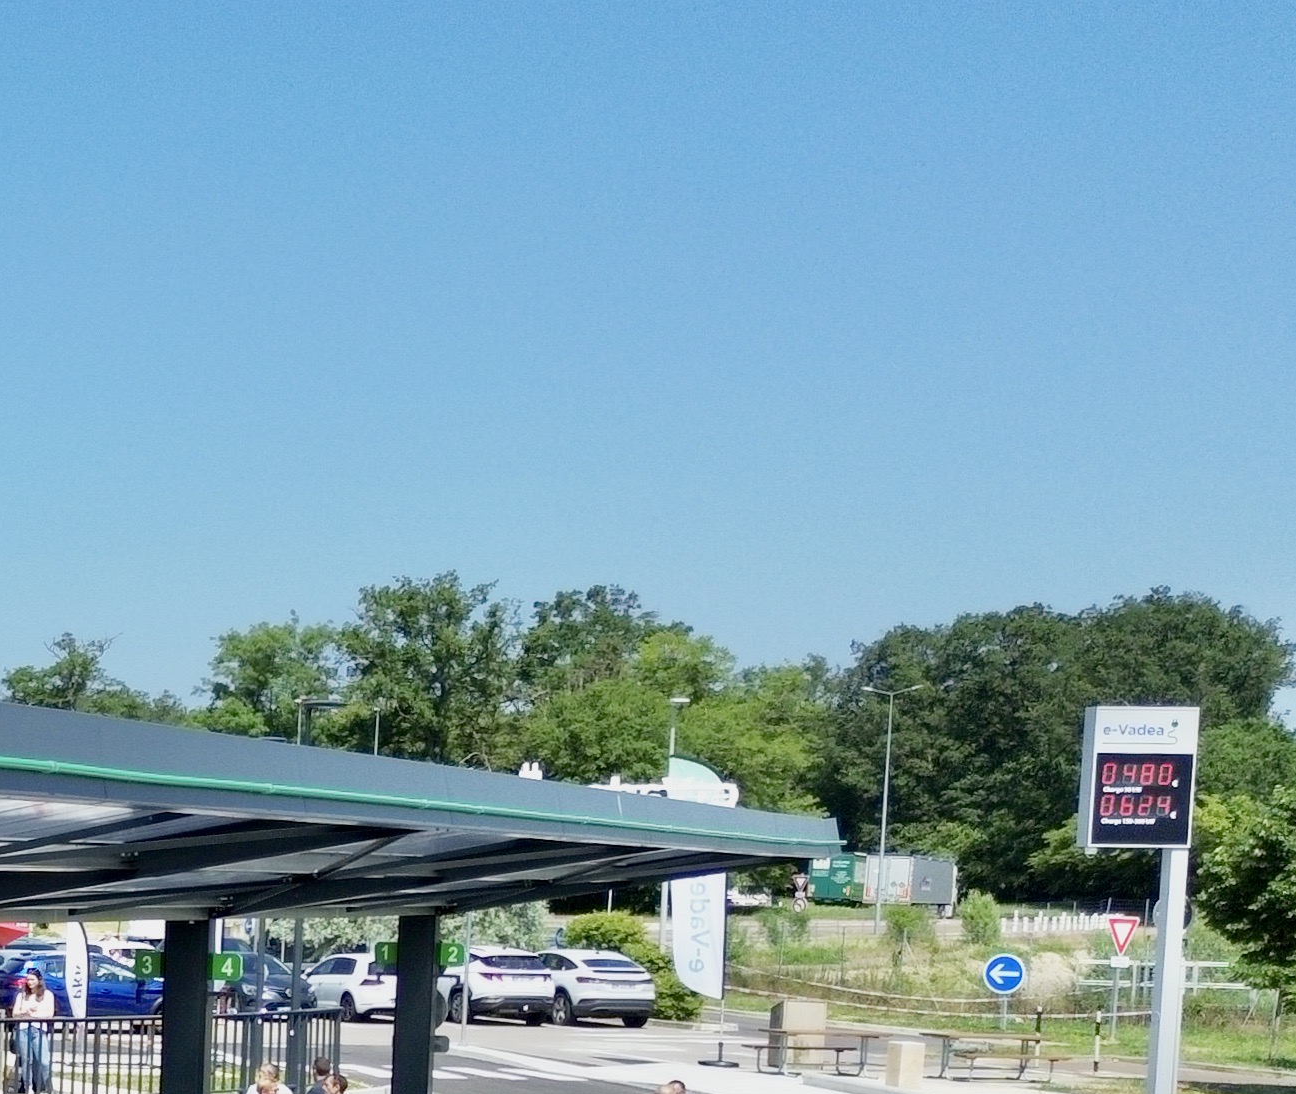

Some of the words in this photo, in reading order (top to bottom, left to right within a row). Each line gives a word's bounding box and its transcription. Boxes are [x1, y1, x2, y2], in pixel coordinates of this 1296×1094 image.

[1103, 724, 1164, 736] e-Vadea
[381, 944, 389, 960] 1
[447, 946, 459, 963] 2
[141, 955, 153, 975] 3
[220, 957, 234, 977] 4
